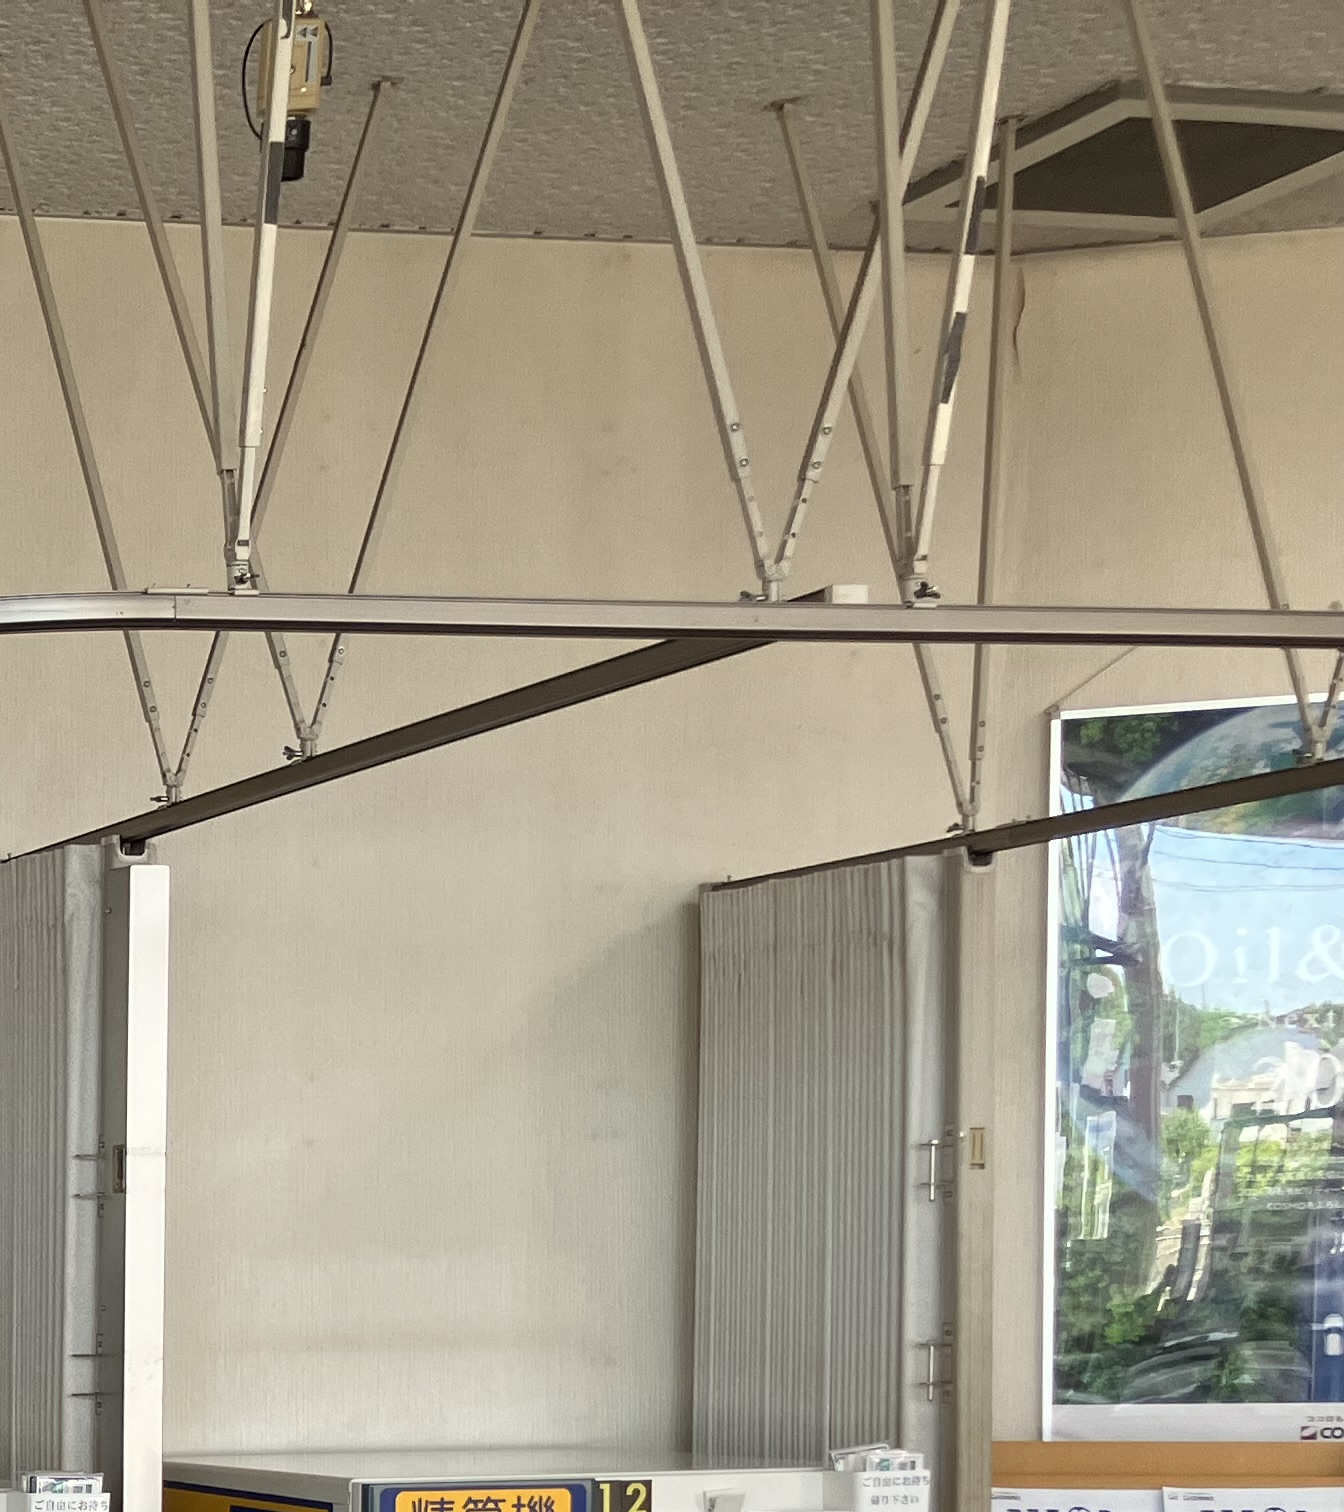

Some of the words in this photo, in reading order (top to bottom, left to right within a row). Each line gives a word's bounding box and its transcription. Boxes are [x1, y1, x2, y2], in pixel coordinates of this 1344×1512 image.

[34, 1499, 108, 1511] ご自由にお持ち
